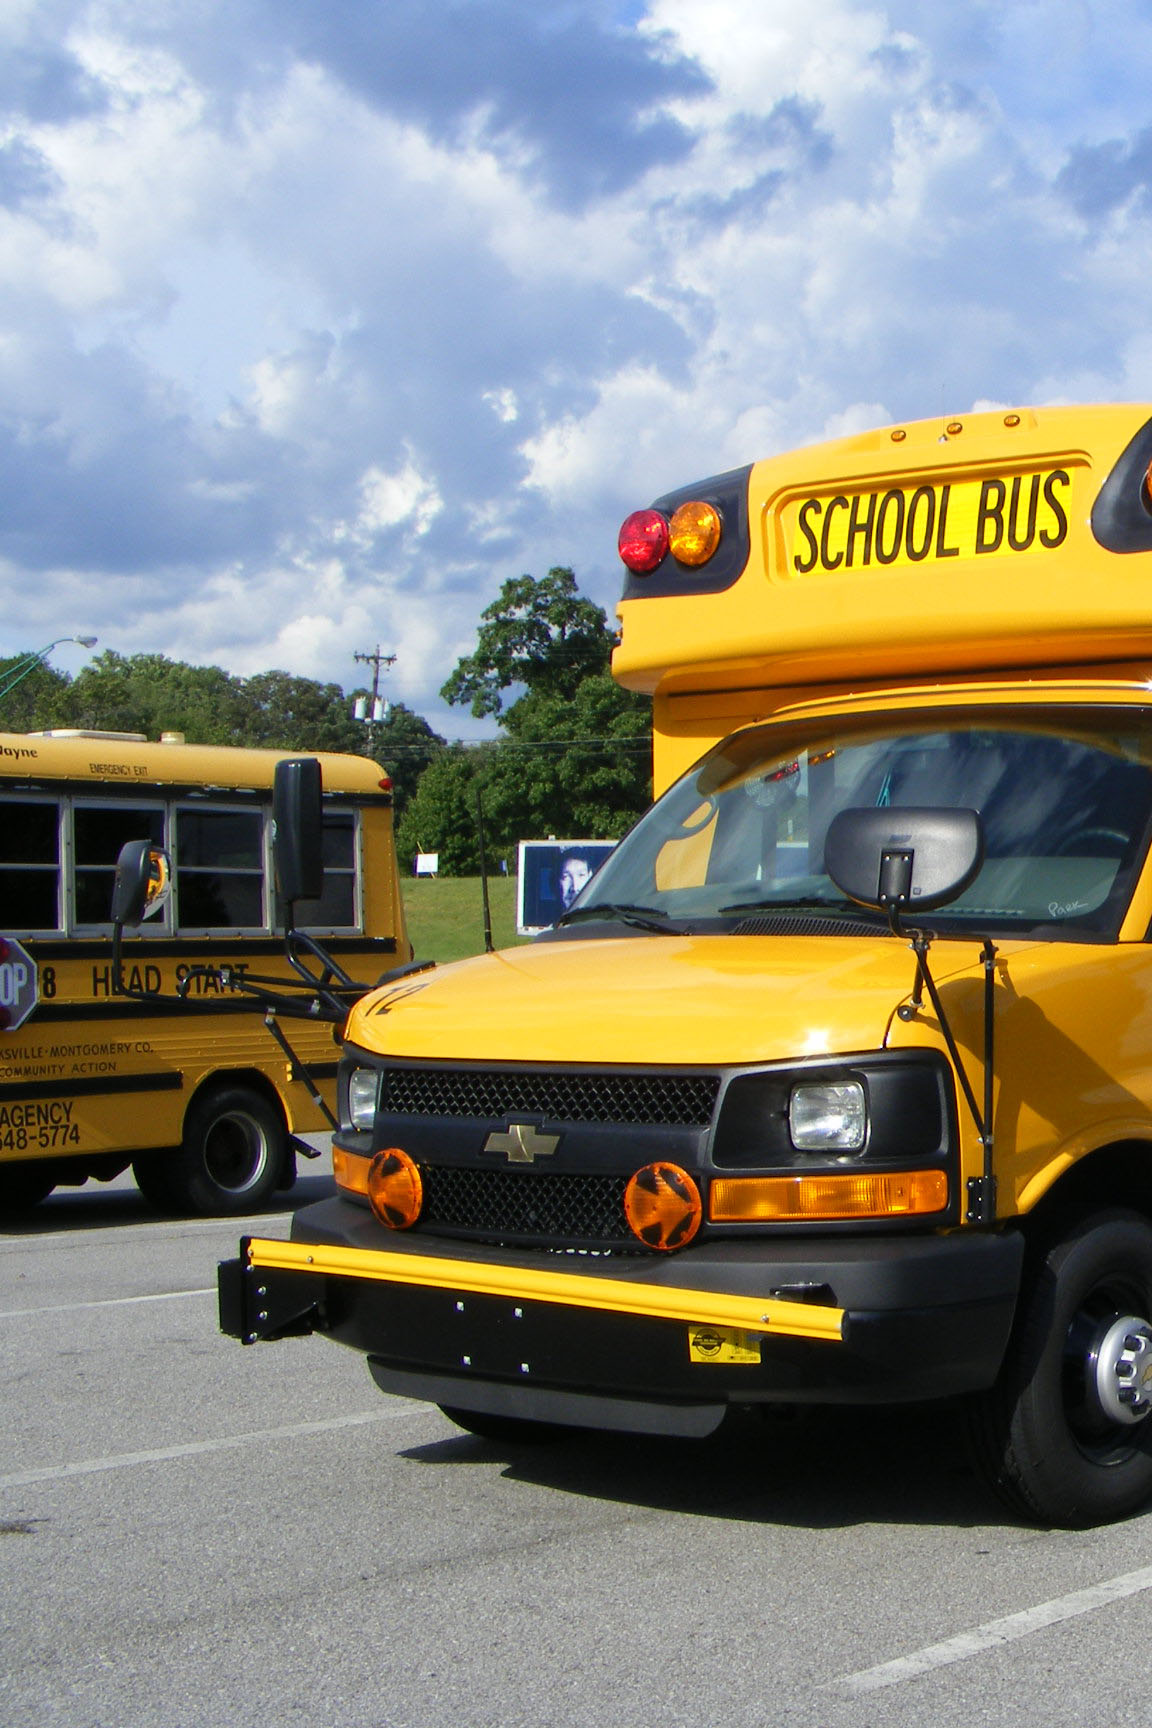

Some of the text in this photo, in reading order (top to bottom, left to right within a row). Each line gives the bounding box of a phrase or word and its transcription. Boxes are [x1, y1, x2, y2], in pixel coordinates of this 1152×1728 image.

[794, 470, 1070, 573] SCHOOL BUS
[89, 763, 148, 776] EMERGENCY EXIT
[42, 966, 56, 998] 8
[93, 965, 161, 997] HEAD
[135, 1042, 154, 1054] CO.
[0, 1062, 117, 1078] COMMUNITY ACTION
[0, 1101, 73, 1129] AGENCY
[0, 1123, 80, 1150] 48-5774
